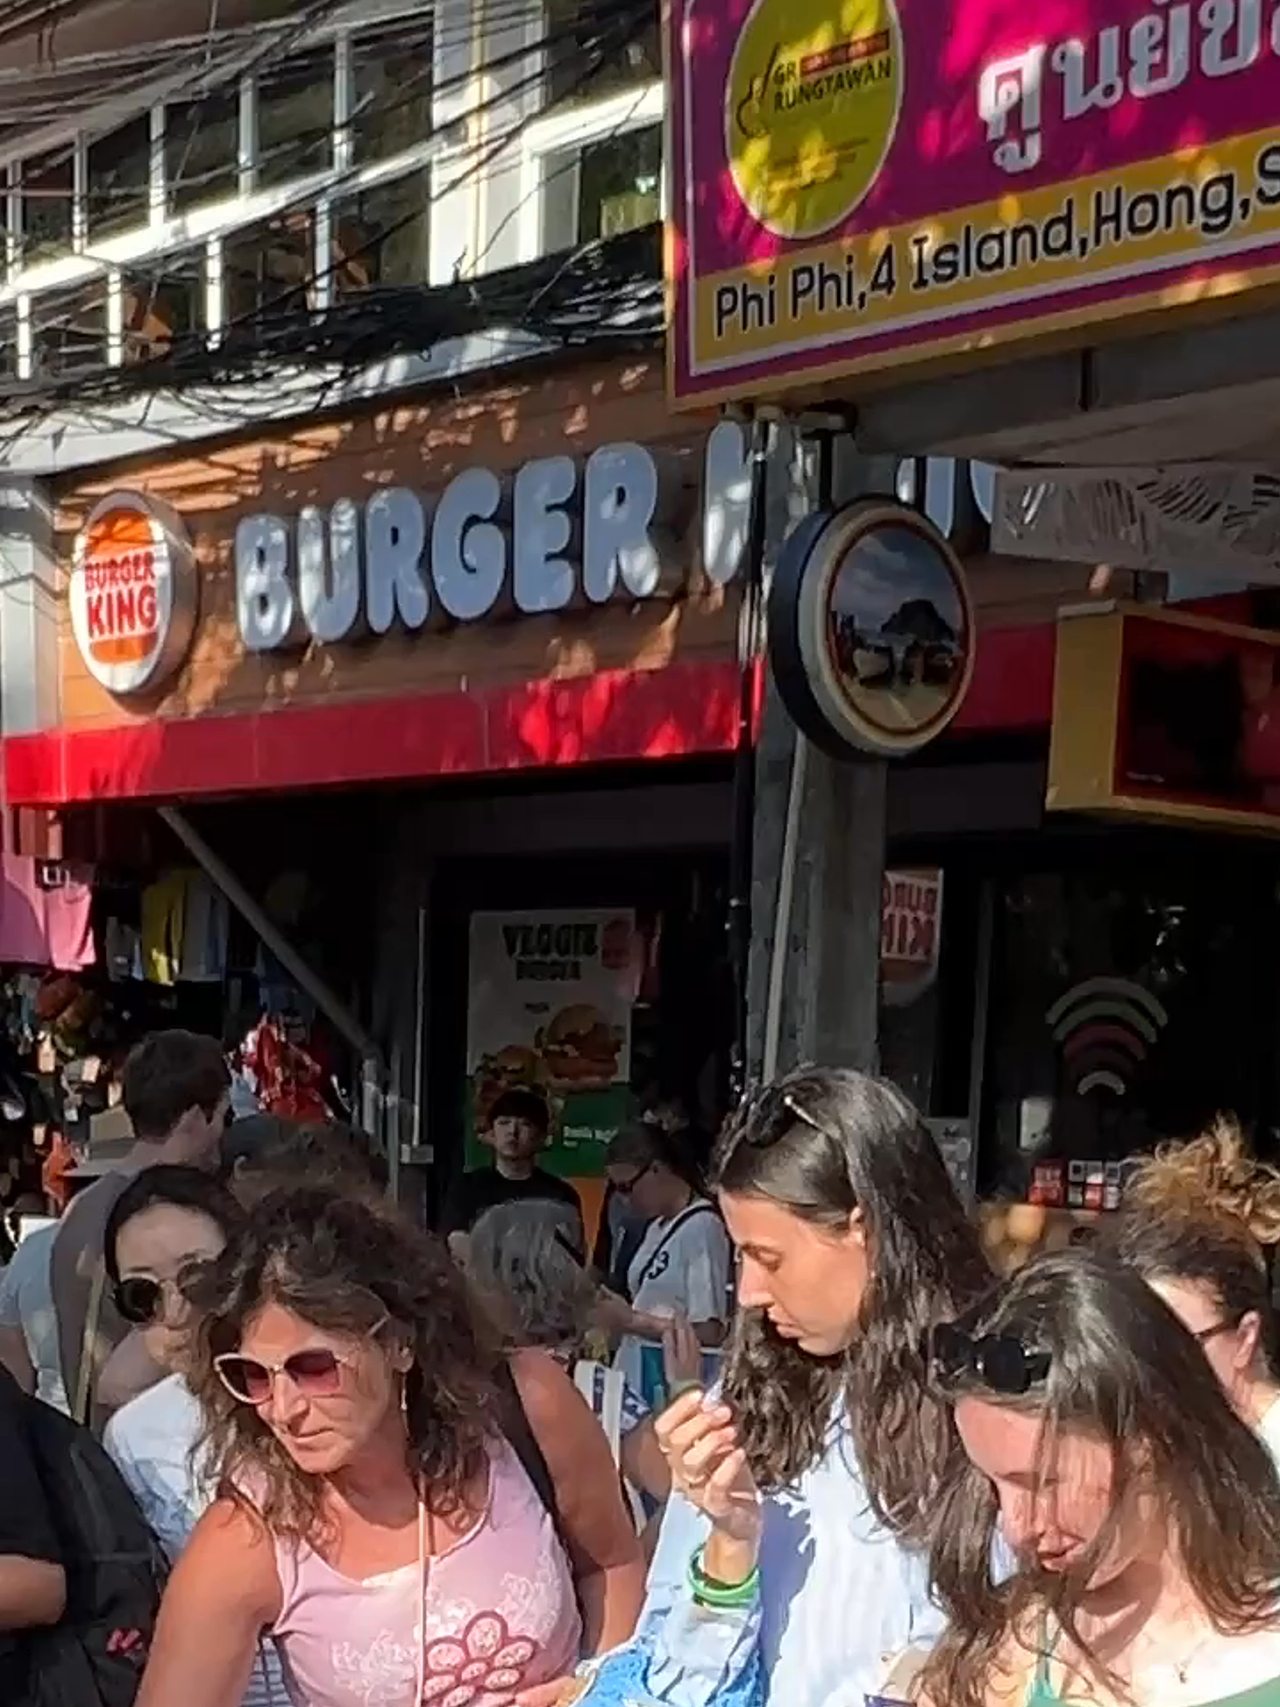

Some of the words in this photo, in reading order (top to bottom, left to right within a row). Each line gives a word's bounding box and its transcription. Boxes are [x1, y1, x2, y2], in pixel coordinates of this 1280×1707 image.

[773, 57, 892, 112] RUNGTAWAN
[716, 272, 776, 339] Phi
[791, 243, 897, 320] Phi,4
[84, 551, 156, 592] BURGER
[235, 441, 662, 651] BURGER
[86, 584, 157, 639] KING
